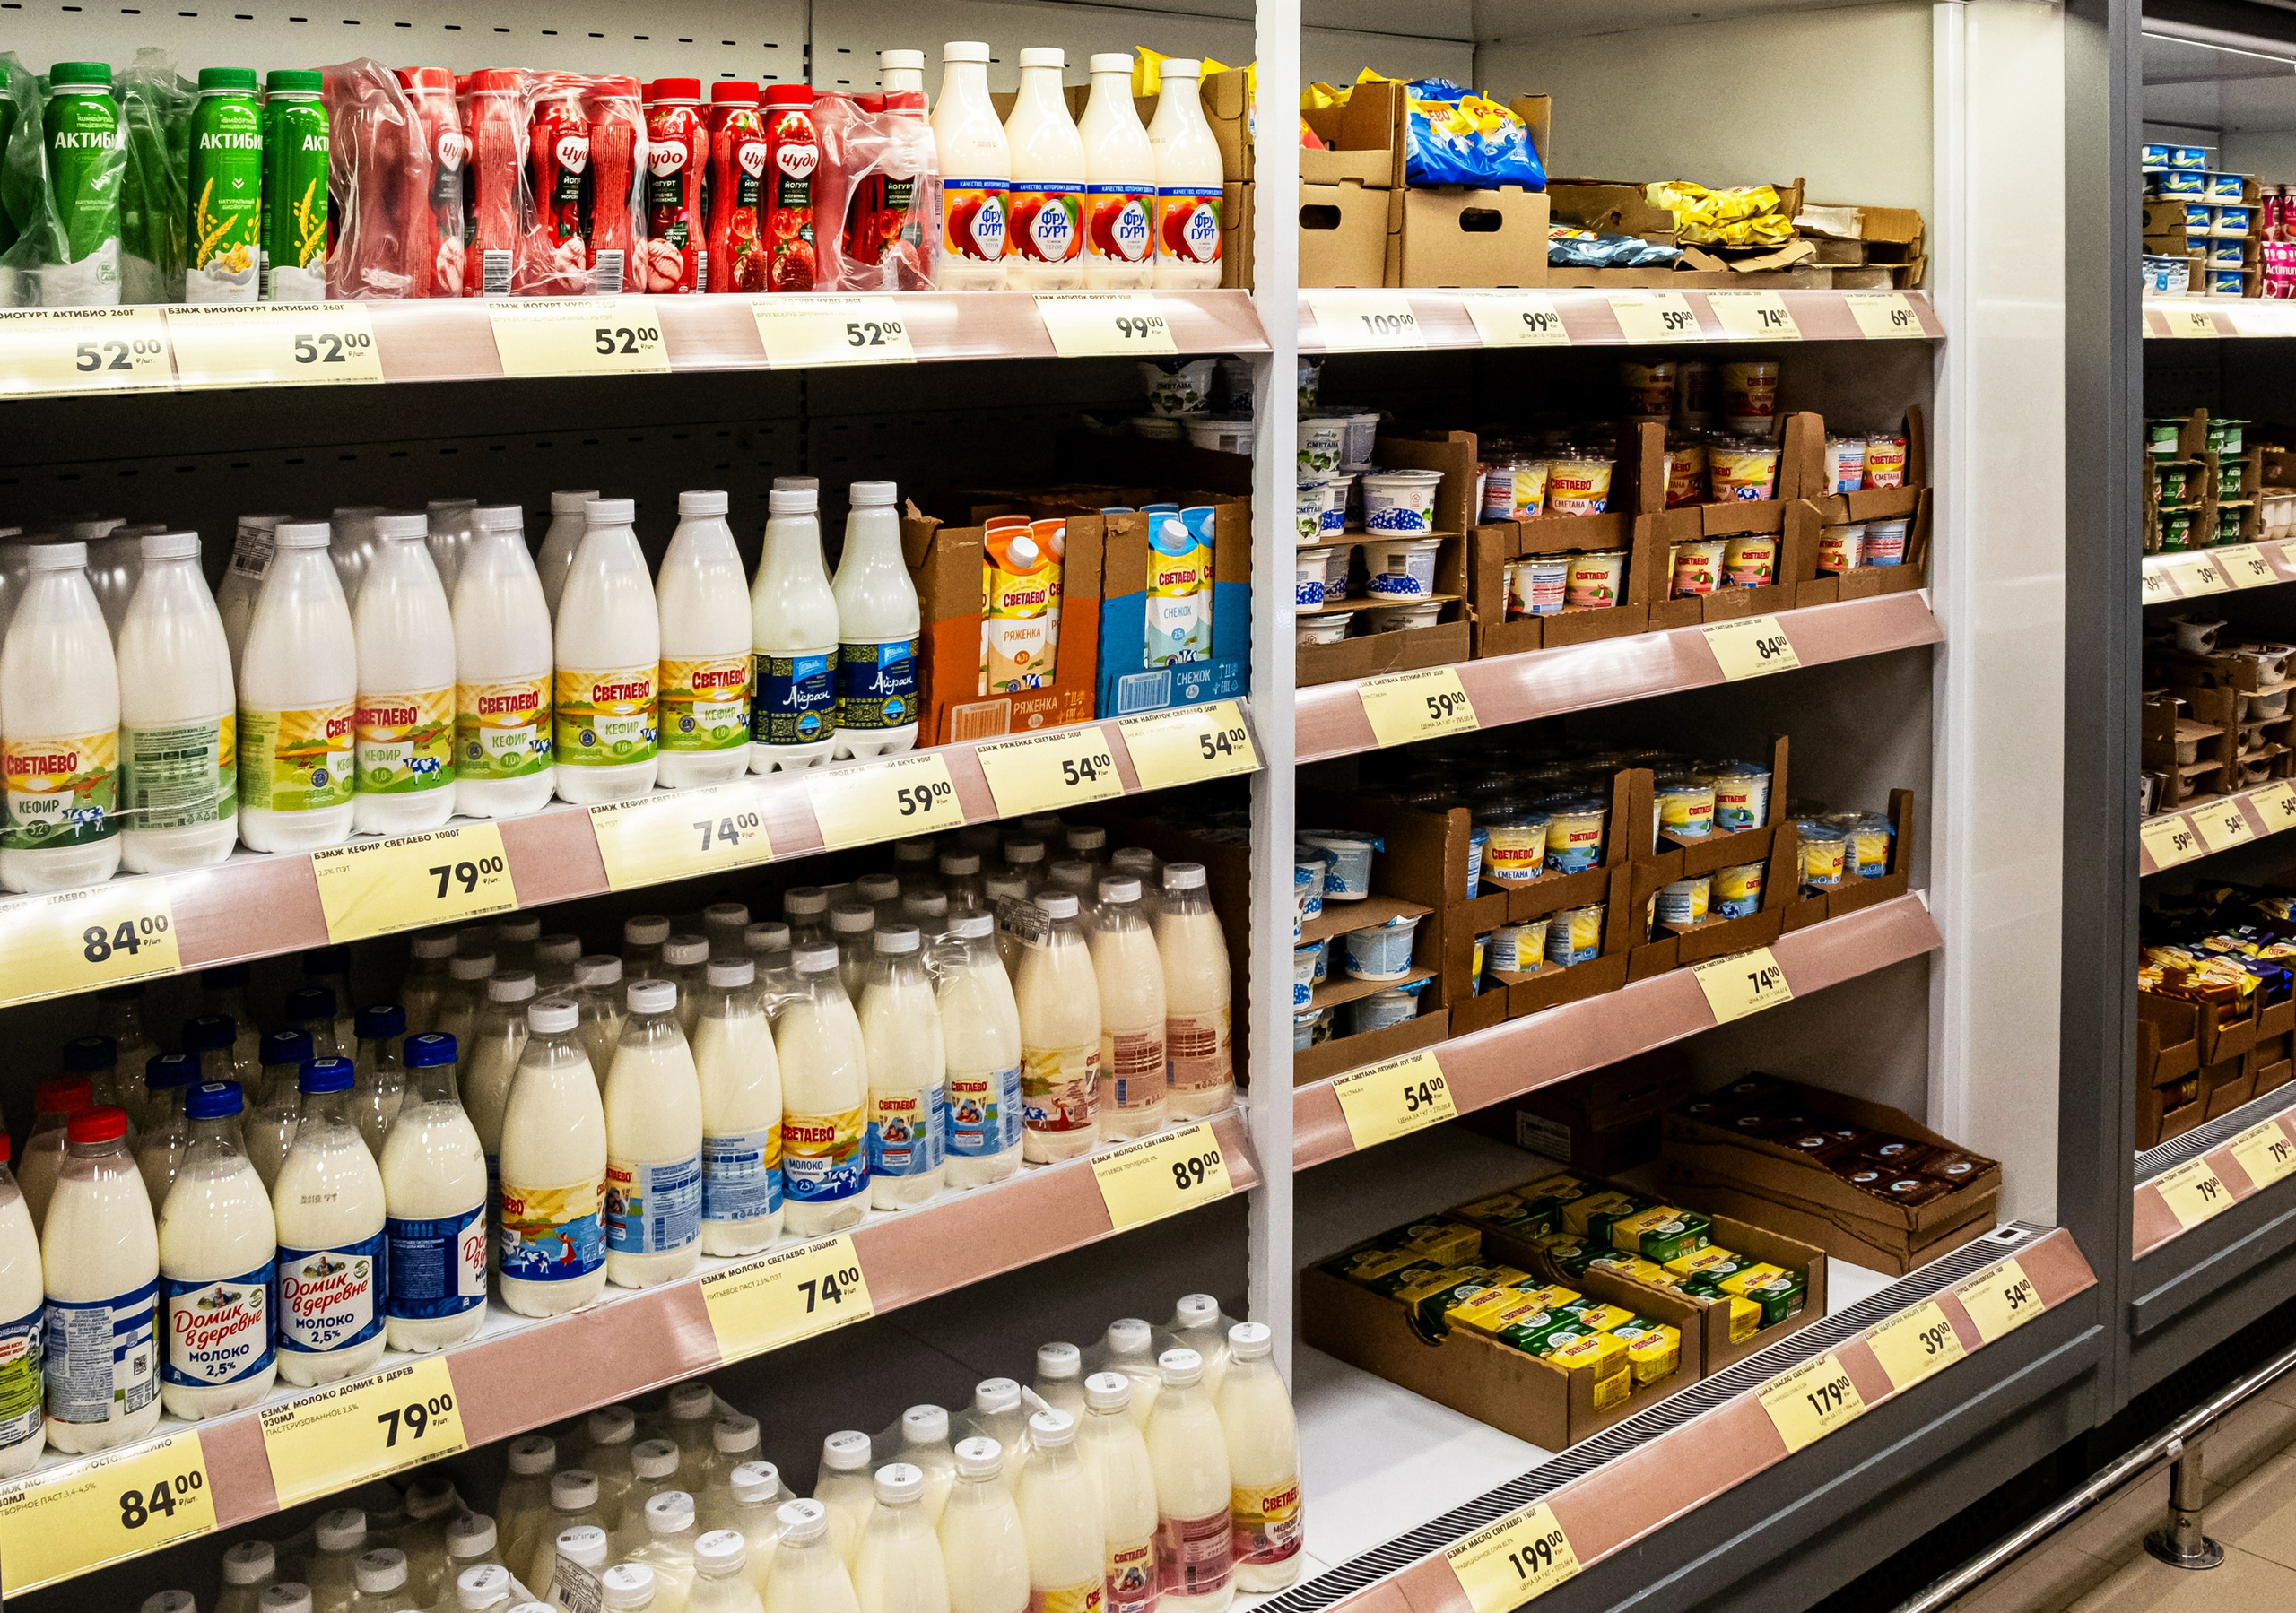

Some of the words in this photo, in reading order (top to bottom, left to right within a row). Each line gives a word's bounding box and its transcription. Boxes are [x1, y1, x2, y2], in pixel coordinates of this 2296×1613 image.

[781, 153, 816, 170] Чудо
[978, 223, 1002, 236] ГУРТ
[1038, 225, 1067, 238] ГУРТ
[1120, 225, 1144, 238] ГУРТ
[1191, 227, 1215, 240] ГУРТ
[53, 310, 107, 318] АКТИБИО
[110, 308, 135, 317] 260Г
[168, 307, 201, 315] БЗМЖ
[204, 305, 267, 314] БИОЙОГУРТ
[271, 304, 319, 312] АКТИБИО
[324, 304, 344, 312] 260Г
[489, 302, 520, 310] БЗМЖ
[522, 300, 561, 309] ЙОГУРТ
[563, 300, 593, 308] ЧУДО
[1116, 317, 1149, 338] 99
[1147, 316, 1164, 327] 00
[1362, 315, 1401, 335] 109
[1523, 313, 1547, 332] 99
[1662, 312, 1684, 330] 59
[1758, 310, 1781, 327] 74
[1891, 310, 1908, 326] 69
[596, 328, 639, 355] 52
[638, 327, 658, 342] 00
[846, 322, 888, 347] 52
[883, 321, 902, 334] 00
[76, 340, 133, 372] 52
[133, 339, 161, 355] 00
[294, 334, 346, 364] 52
[344, 333, 370, 349] 00
[1551, 479, 1593, 490] СВЕТАЕВО
[1554, 499, 1586, 509] СМЕТАНА
[1159, 568, 1196, 586] СВЕТАЕВО
[2197, 568, 2213, 583] 39
[2248, 560, 2265, 575] 39
[1004, 590, 1046, 607] СВЕТАЕВО
[1164, 605, 1192, 619] СНЕЖОК
[1004, 628, 1041, 642] РЯЖЕНКА
[1756, 637, 1781, 659] 84
[692, 667, 746, 689] СВЕТАЕВО
[869, 671, 913, 695] Айран
[1177, 669, 1211, 686] СНЕЖОК
[592, 681, 650, 702] СВЕТАЕВО
[783, 685, 830, 710] Айран
[478, 694, 538, 715] СВЕТАЕВО
[705, 707, 735, 721] КЕФИР
[1013, 696, 1057, 715] РЯЖЕНКА
[1426, 694, 1454, 719] 59
[1140, 713, 1171, 723] НАПИТОК
[604, 722, 639, 736] КЕФИР
[492, 733, 527, 748] КЕФИР
[978, 744, 999, 753] БЗМЖ
[1000, 740, 1032, 750] РЯЖЕНКА
[1034, 734, 1065, 745] СВЕТАЕВО
[1199, 732, 1232, 760] 54
[1229, 727, 1246, 742] 00
[7, 752, 78, 775] СВЕТАЕВО
[364, 750, 401, 761] КЕФИР
[1062, 757, 1097, 786] 54
[1093, 753, 1110, 767] 00
[19, 800, 60, 814] КЕФИР
[590, 803, 618, 815] БЗМЖ
[620, 799, 649, 810] КЕФИР
[897, 785, 933, 816] 59
[931, 782, 952, 797] 00
[692, 821, 739, 852] 74
[737, 812, 759, 829] 00
[2224, 817, 2241, 834] 54
[314, 848, 344, 860] БЗМЖ
[347, 842, 380, 855] КЕФИР
[384, 834, 431, 850] СВЕТАЕВО
[435, 828, 460, 840] 1000Г
[2172, 834, 2187, 851] 59
[1492, 848, 1534, 860] СВЕТАЕВО
[429, 862, 479, 899] 79
[478, 855, 504, 876] 00
[83, 921, 141, 964] 84
[140, 915, 168, 935] 00
[1747, 969, 1773, 994] 74
[1404, 1081, 1433, 1112] 54
[1429, 1077, 1444, 1091] 00
[1113, 1145, 1143, 1159] МОЛОКО
[1144, 1136, 1175, 1151] СВЕТАЕВО
[2268, 1143, 2288, 1163] 79
[789, 1158, 823, 1171] МОЛОКО
[1172, 1157, 1205, 1190] 89
[1203, 1150, 1220, 1166] 00
[2196, 1181, 2217, 1202] 79
[701, 1272, 726, 1286] БЗМЖ
[728, 1261, 765, 1278] МОЛОКО
[767, 1248, 806, 1266] СВЕТАЕВО
[808, 1238, 838, 1253] 1000МЛ
[283, 1273, 348, 1299] Домик
[706, 1287, 738, 1301] ПИТЬЕВОЕ
[797, 1274, 842, 1314] 74
[839, 1267, 859, 1286] 00
[2004, 1284, 2028, 1310] 54
[173, 1303, 244, 1333] Домик
[296, 1313, 354, 1329] МОЛОКО
[311, 1330, 341, 1344] 2,5%
[1919, 1327, 1944, 1355] 39
[189, 1344, 249, 1363] МОЛОКО
[205, 1362, 236, 1376] 2,5%
[260, 1405, 291, 1418] БЗМЖ
[293, 1390, 337, 1409] МОЛОКО
[339, 1378, 375, 1395] ДОМИК
[386, 1366, 414, 1382] ДЕРЕВ
[1807, 1383, 1843, 1416] 179
[262, 1412, 295, 1428] 930МЛ
[265, 1410, 342, 1436] ПАСТЕРИЗОВАННОЕ
[378, 1402, 429, 1448] 79
[428, 1393, 454, 1415] 00
[119, 1480, 177, 1530] 84
[175, 1470, 203, 1494] 00
[1468, 1532, 1492, 1548] МАСЛО
[1492, 1516, 1523, 1536] СВЕТАЕВО
[1509, 1539, 1552, 1580] 199
[1547, 1530, 1563, 1547] 00
